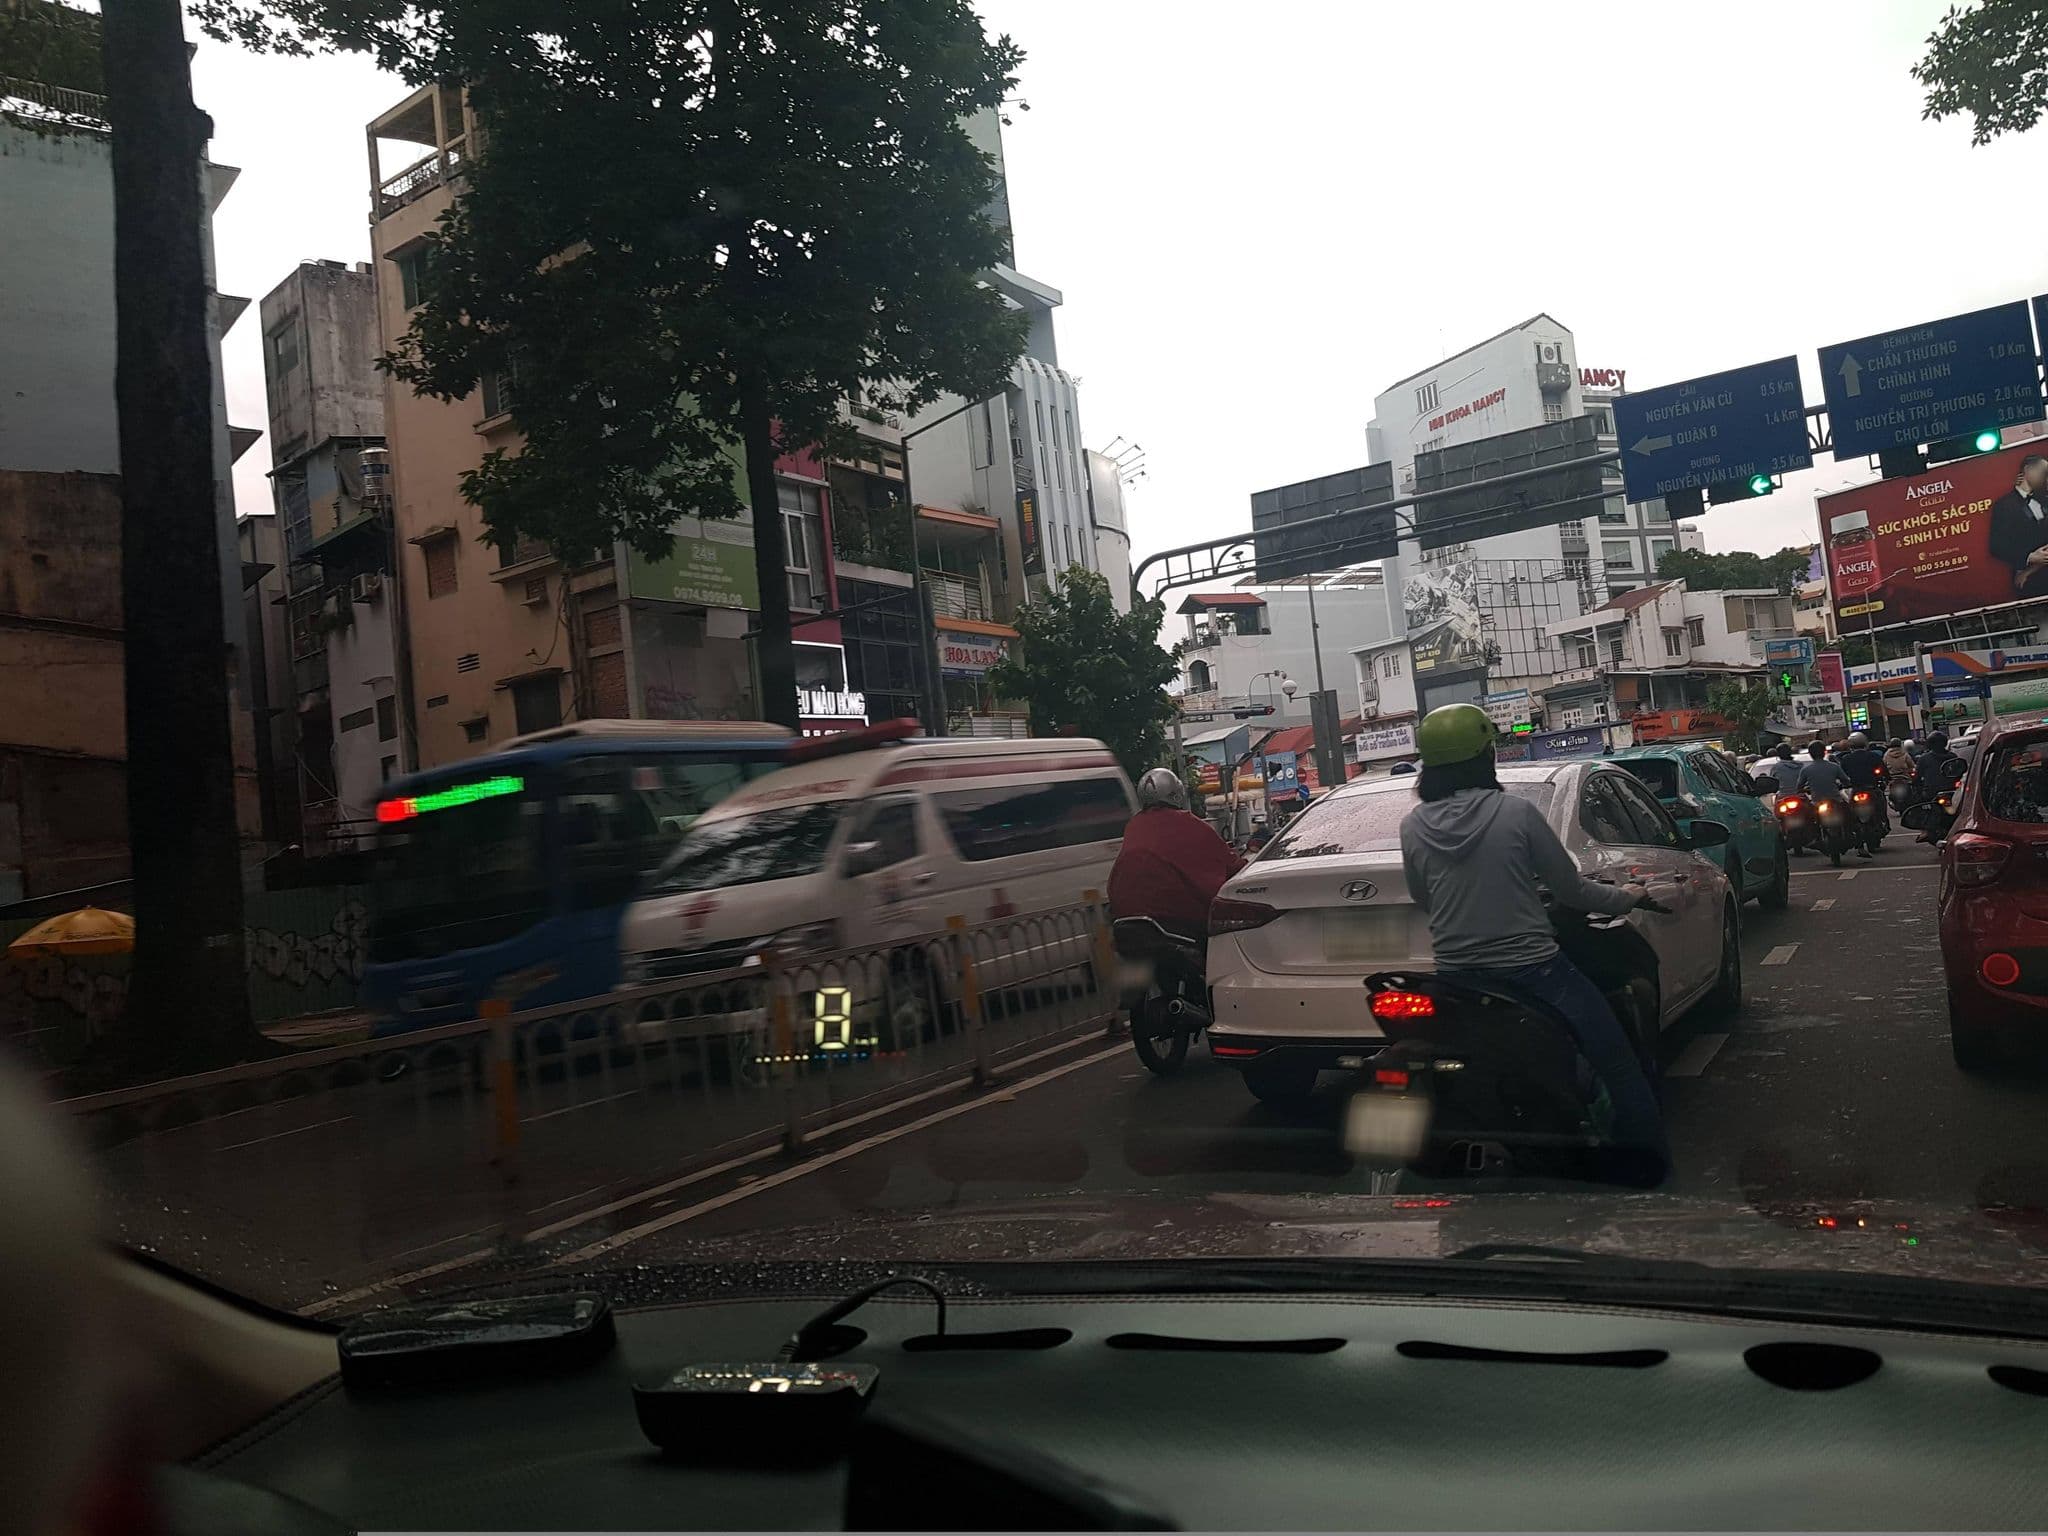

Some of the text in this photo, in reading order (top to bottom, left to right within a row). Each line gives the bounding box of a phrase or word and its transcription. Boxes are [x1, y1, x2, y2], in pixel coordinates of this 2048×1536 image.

[1906, 340, 1957, 361] THƯƠNG
[2007, 342, 2026, 356] Km
[1778, 379, 1794, 393] Km
[2013, 384, 2032, 399] Km
[1473, 388, 1506, 413] NANCY
[1693, 394, 1716, 413] VĂN
[1933, 392, 1985, 416] PHƯƠNG
[1781, 408, 1799, 423] Km
[2016, 404, 2035, 419] Km
[1677, 424, 1718, 445] QUẬN 8
[1925, 417, 1950, 438] LỚN
[1789, 453, 1806, 467] Km
[1728, 462, 1756, 480] LINH
[1905, 479, 1954, 501] ANGELA
[1877, 518, 1902, 537] SỨC
[1903, 511, 1941, 530] KHỎE,
[1968, 498, 1993, 515] ĐẸP
[1903, 530, 1932, 546] SINH
[1934, 524, 1948, 539] LÝ
[1951, 520, 1971, 536] NỮ
[1836, 559, 1877, 577] ANGELA
[1934, 560, 1951, 570] 556
[1951, 555, 1968, 566] 889
